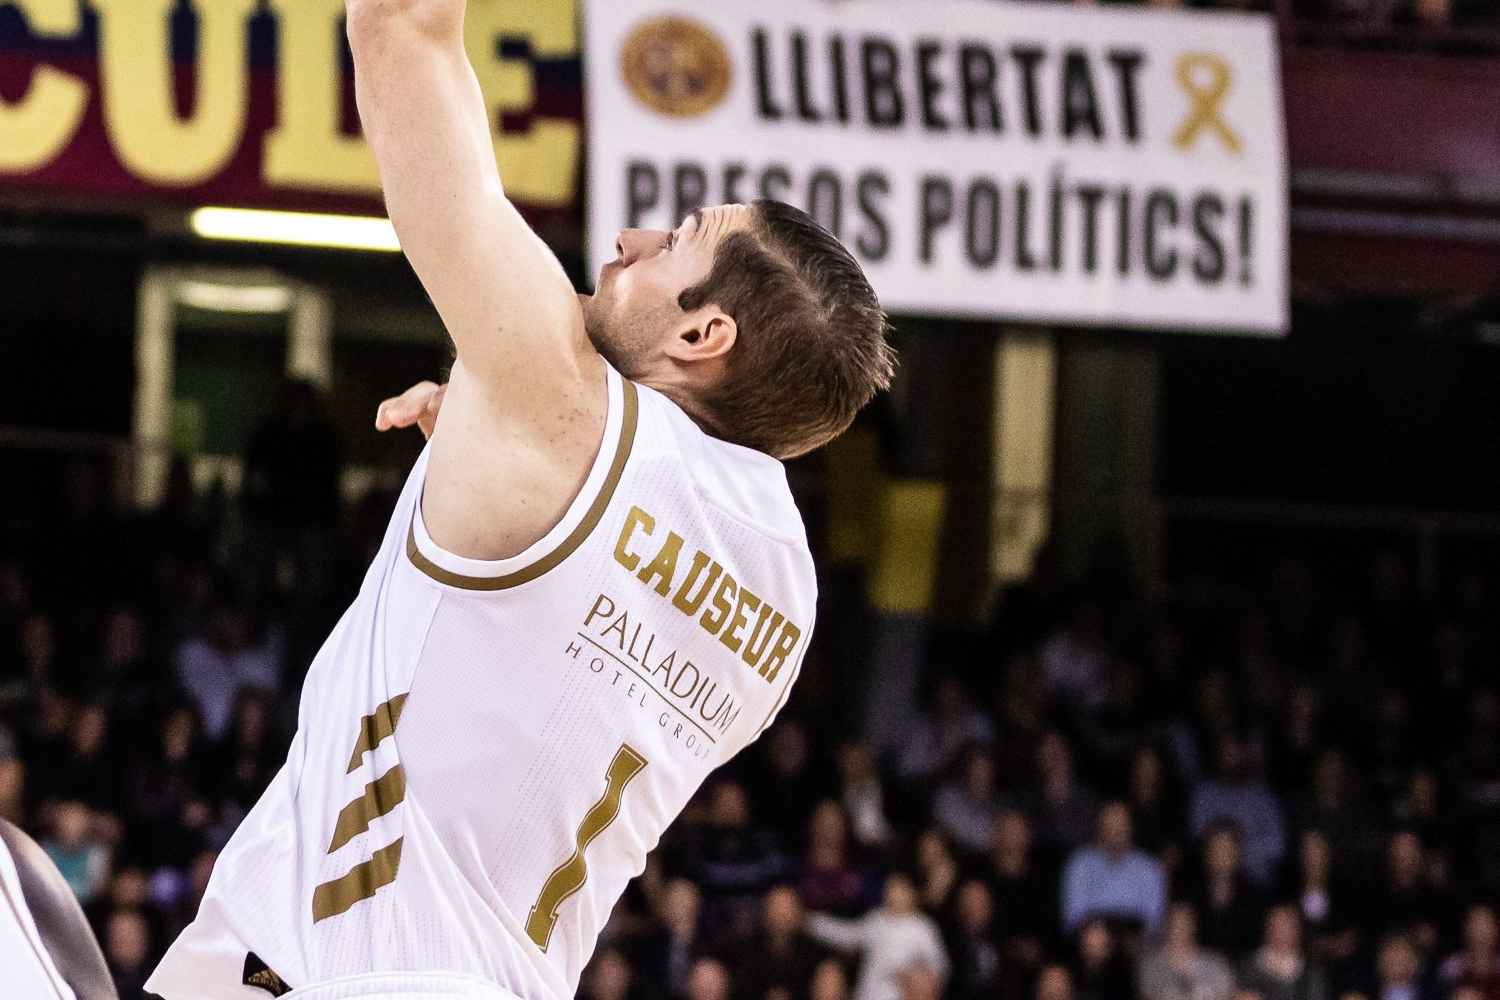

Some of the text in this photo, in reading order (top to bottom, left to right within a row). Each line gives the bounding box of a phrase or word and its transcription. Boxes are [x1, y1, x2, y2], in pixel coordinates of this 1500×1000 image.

[747, 24, 1150, 145] LLIBERTAT
[919, 160, 1257, 288] POLÍTICS!
[613, 506, 802, 683] CAUSEUR
[565, 641, 647, 708] HOTEL
[583, 594, 741, 736] PALLADIUM
[524, 743, 649, 954] 1
